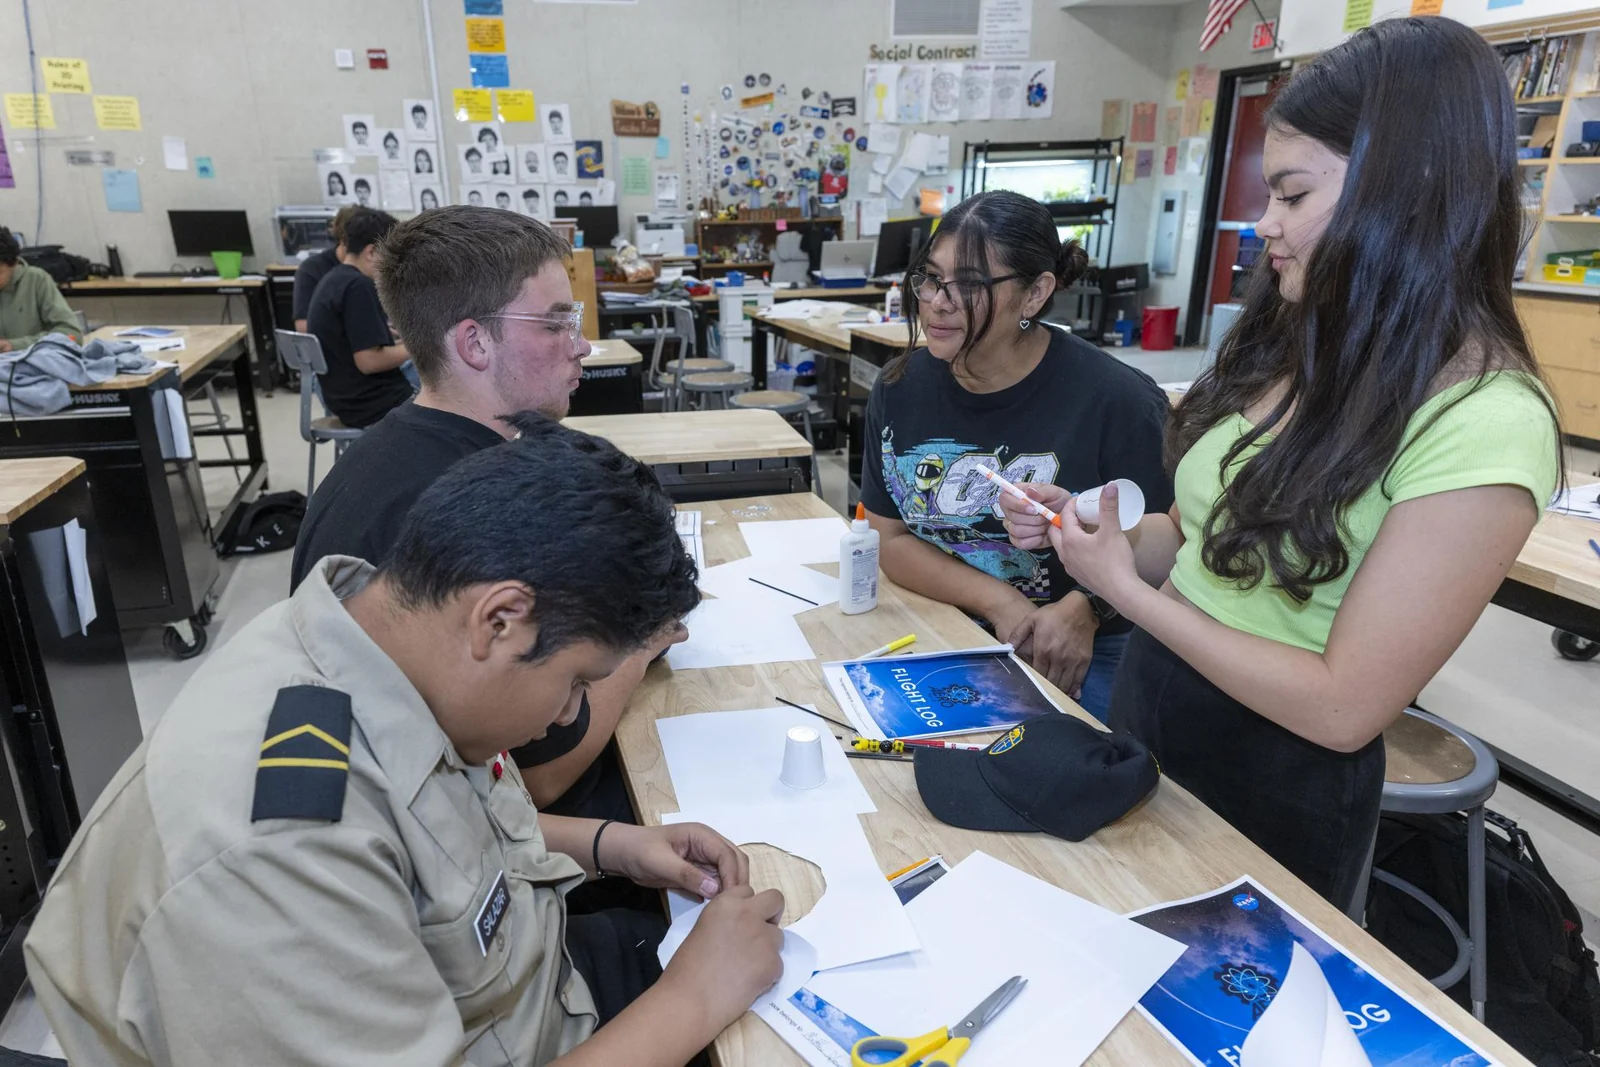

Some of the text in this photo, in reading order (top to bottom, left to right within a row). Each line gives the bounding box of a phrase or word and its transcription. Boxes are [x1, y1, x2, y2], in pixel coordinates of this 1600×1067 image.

[869, 43, 977, 62] Social Contract
[591, 367, 627, 378] HUSKY
[74, 393, 120, 405] HUSKY
[891, 668, 943, 727] FLIGHT LOG
[779, 1010, 798, 1027] belongs
[1343, 1003, 1391, 1030] OG
